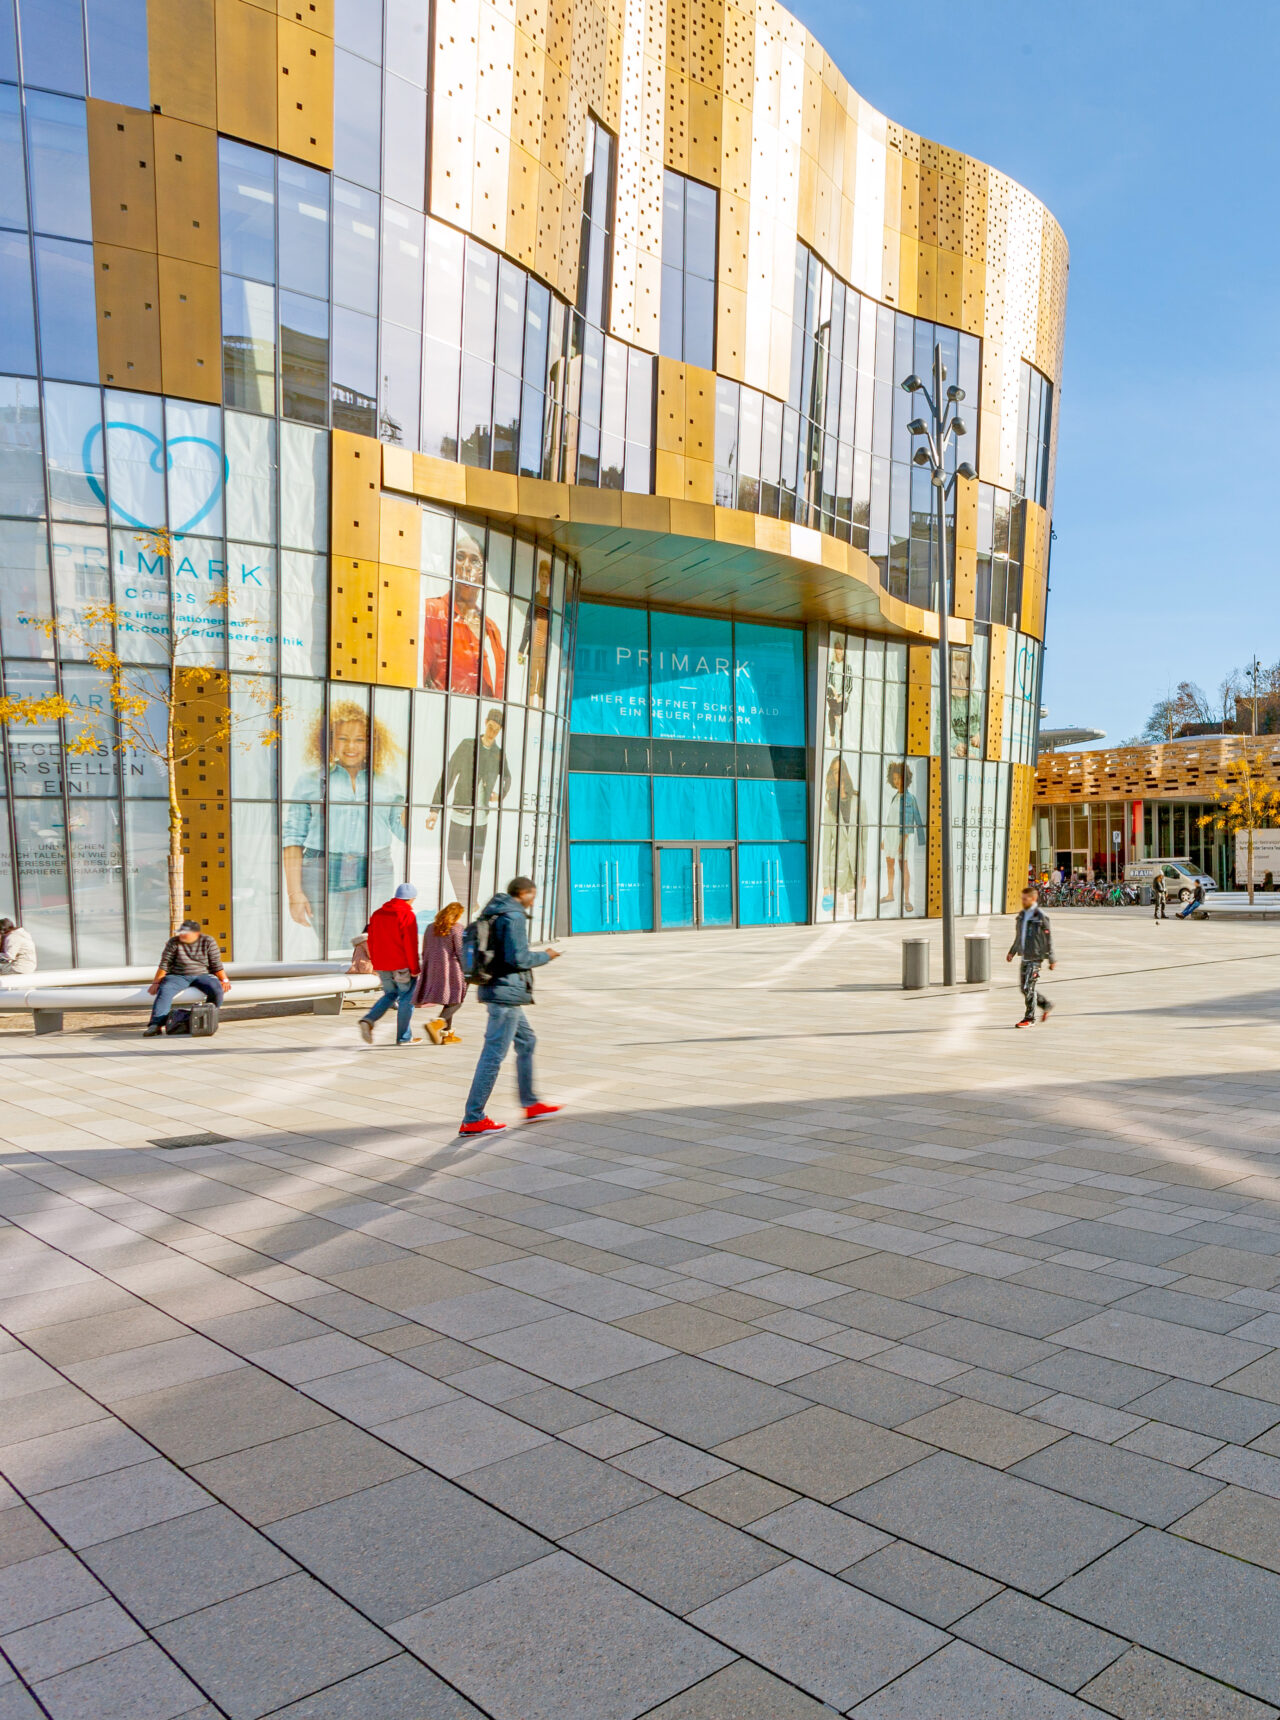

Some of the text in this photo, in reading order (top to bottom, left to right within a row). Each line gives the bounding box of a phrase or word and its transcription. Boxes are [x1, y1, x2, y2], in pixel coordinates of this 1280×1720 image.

[46, 543, 263, 586] PRIMARK
[616, 646, 751, 679] PRIMARK
[591, 694, 623, 704] HIER
[751, 706, 779, 716] BALD
[620, 707, 642, 716] EIN
[697, 713, 751, 725] PRIMARK
